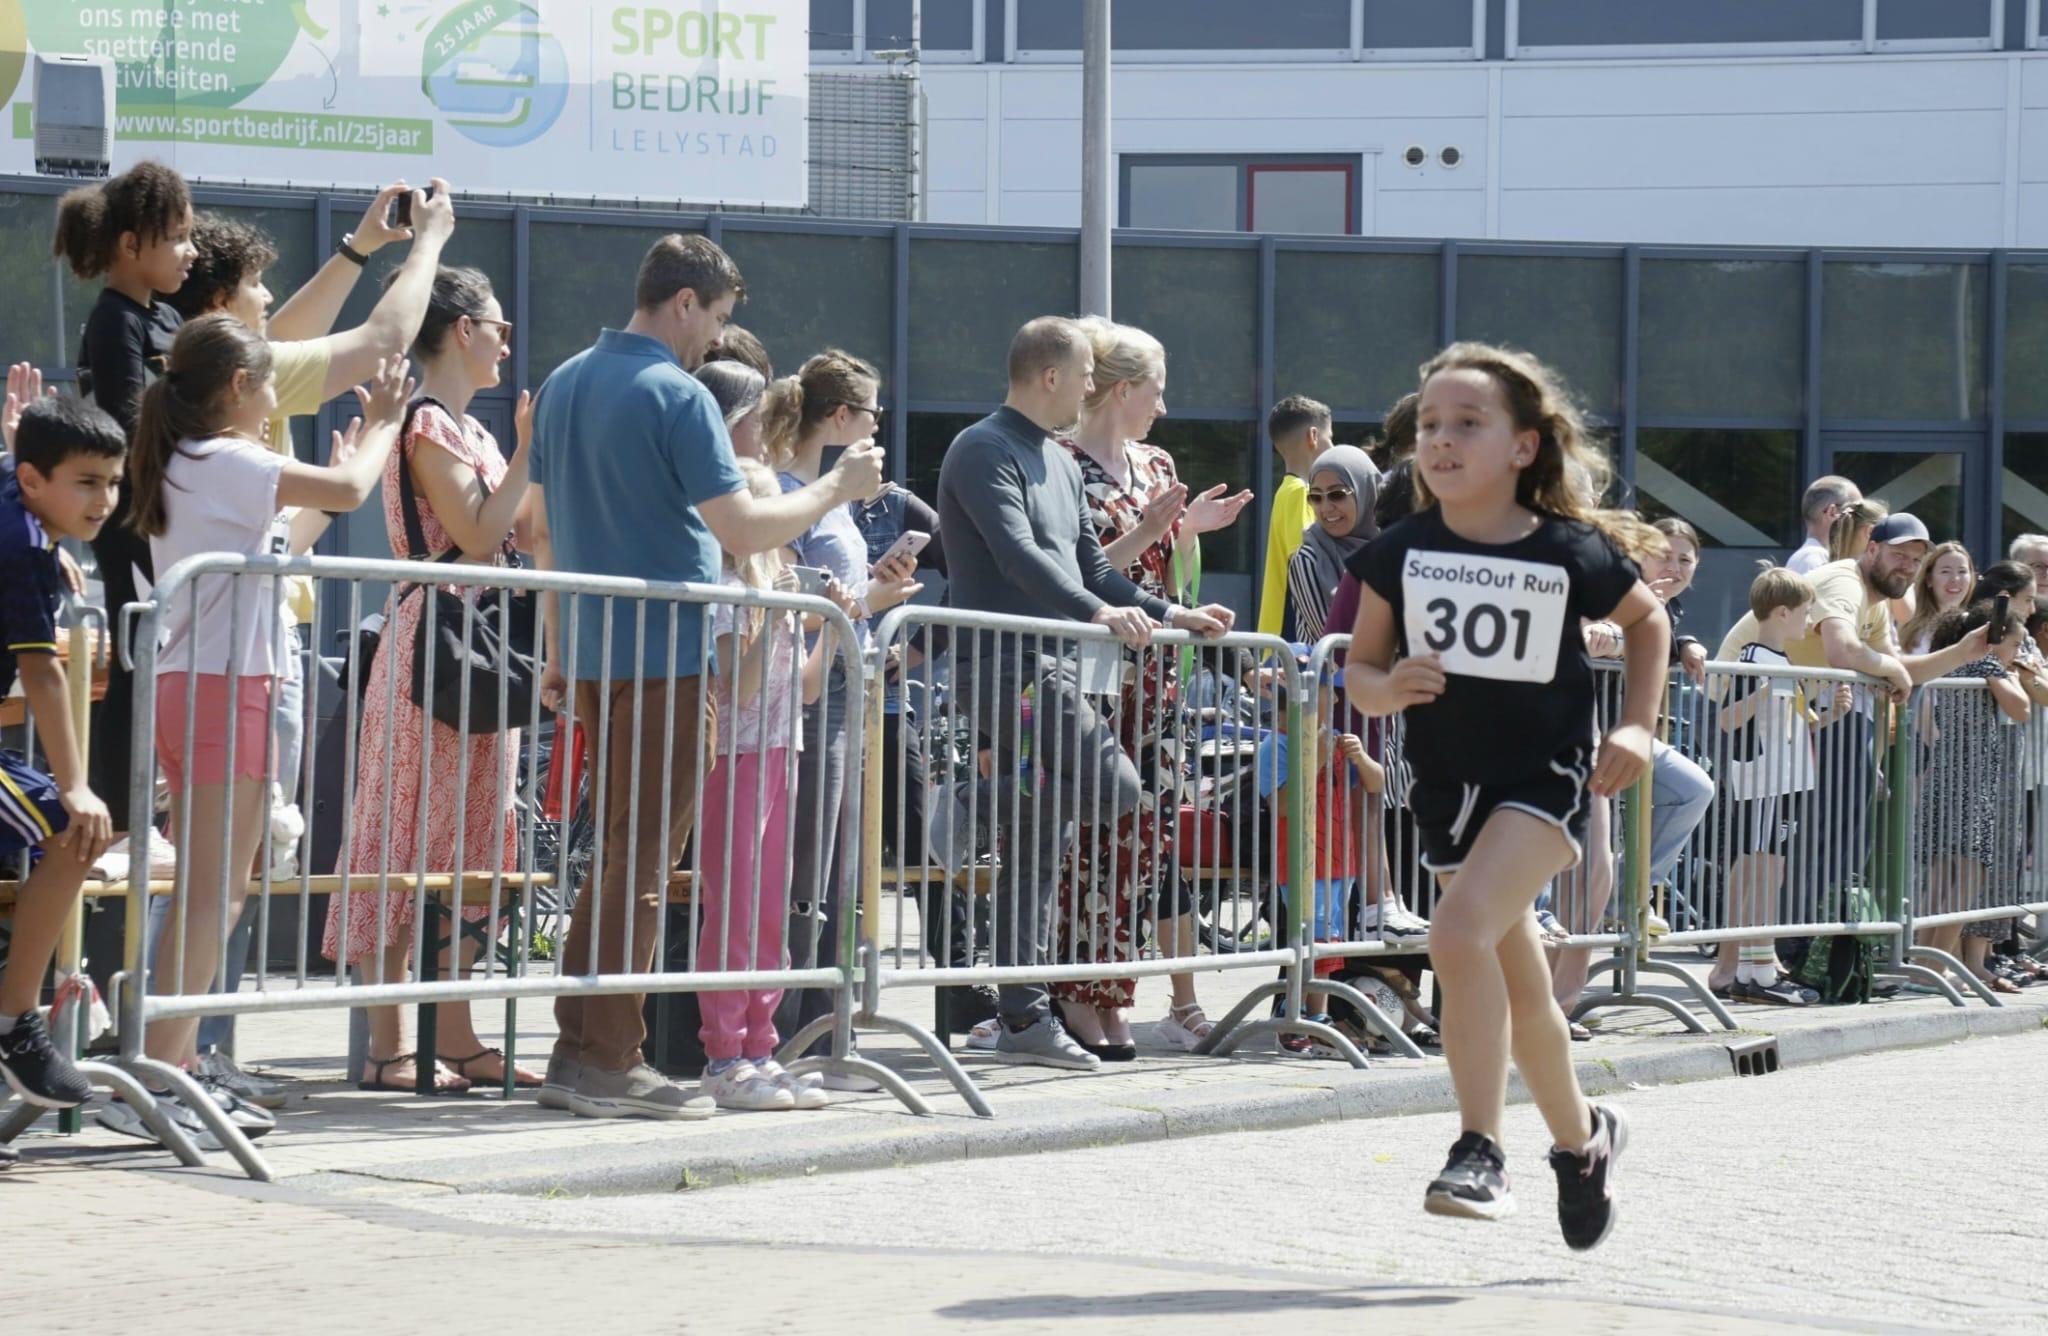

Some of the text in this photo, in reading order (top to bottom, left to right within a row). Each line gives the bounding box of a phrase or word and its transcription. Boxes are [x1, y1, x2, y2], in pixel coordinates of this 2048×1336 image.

[80, 8, 241, 33] ons mee met
[434, 5, 498, 57] 25 JAAR
[611, 7, 778, 61] SPORT
[83, 36, 237, 63] spetterende
[115, 63, 237, 93] tiviteiten.
[612, 71, 777, 116] BEDRIJF
[115, 115, 422, 148] www.sportbedrijf.nl/25jaar
[612, 128, 777, 158] LELYSTAD
[1407, 560, 1564, 595] ScoolsOut Run
[1424, 597, 1532, 661] 301
